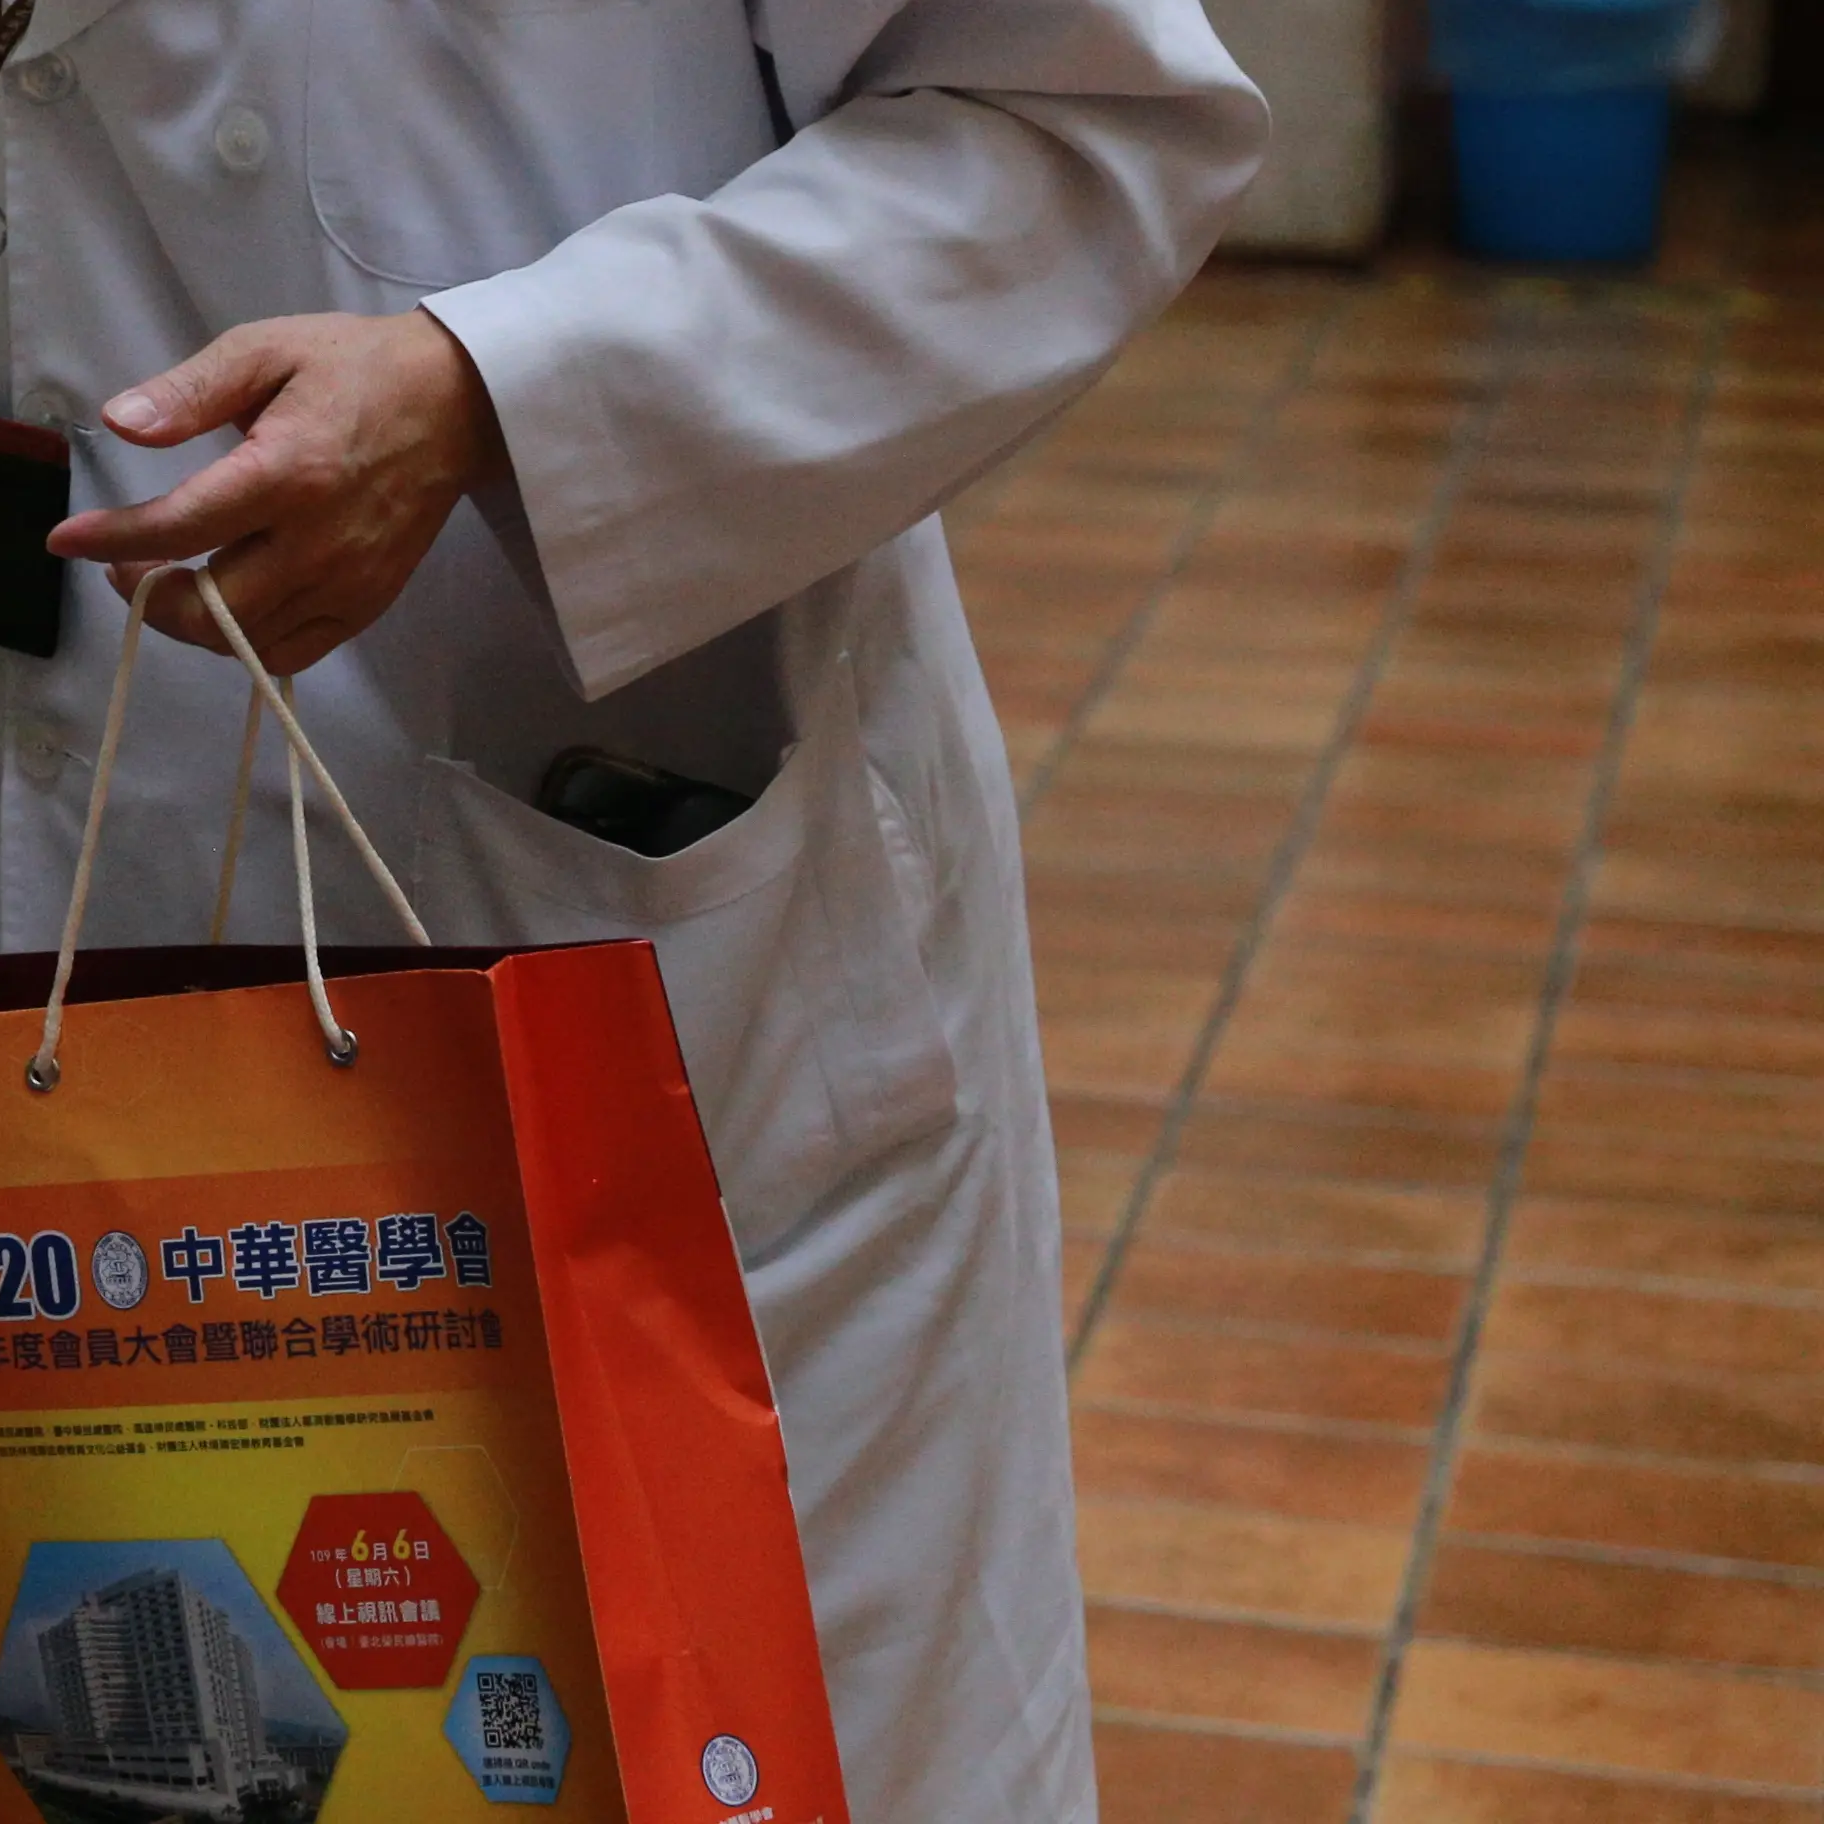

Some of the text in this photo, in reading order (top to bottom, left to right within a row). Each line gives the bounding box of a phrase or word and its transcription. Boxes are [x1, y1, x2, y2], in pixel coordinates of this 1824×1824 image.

[160, 1210, 493, 1303] 中華醫學會
